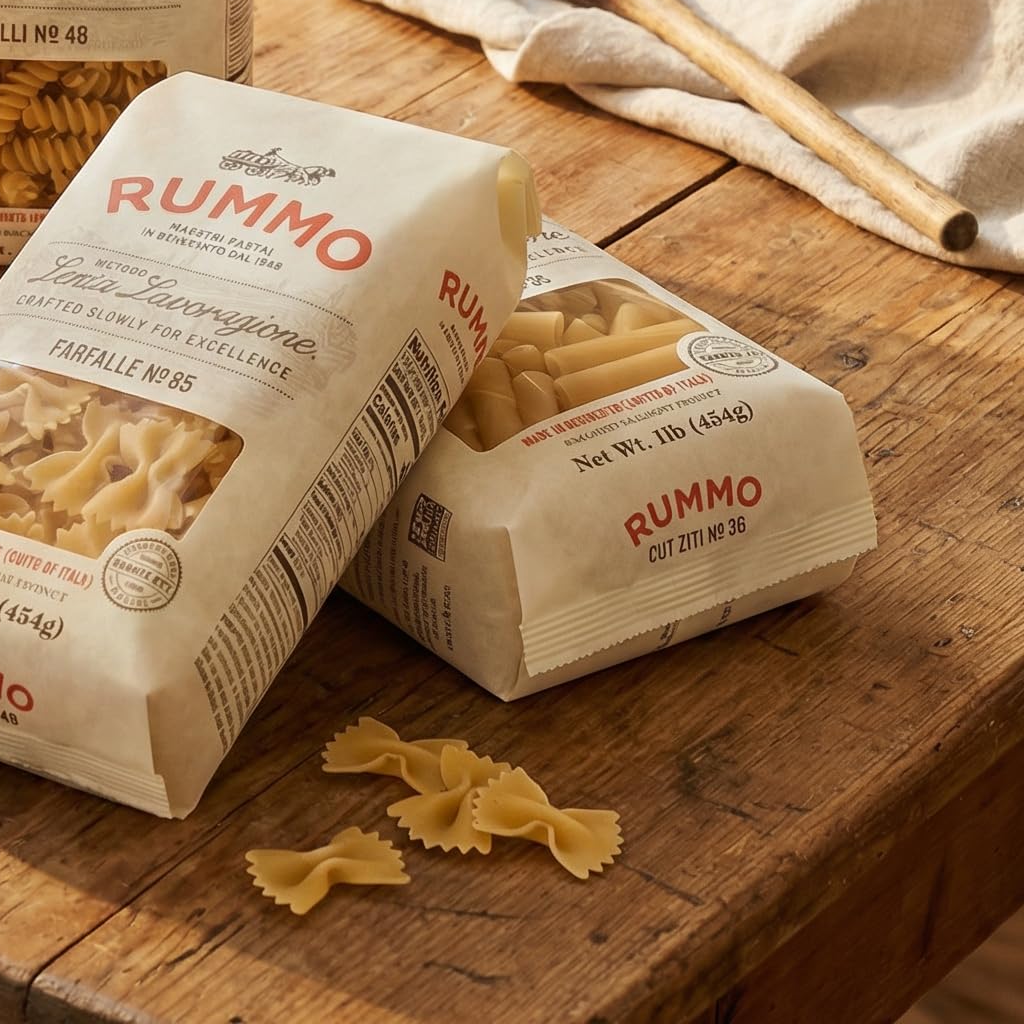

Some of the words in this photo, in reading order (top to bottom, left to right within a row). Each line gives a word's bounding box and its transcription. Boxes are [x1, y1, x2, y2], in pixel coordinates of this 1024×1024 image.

[65, 24, 89, 45] 48
[106, 175, 373, 272] RUMMO
[140, 226, 156, 238] IN
[227, 249, 252, 264] DAL
[16, 294, 84, 315] CRAFTED
[86, 307, 148, 331] SLOWLY
[151, 324, 182, 342] FOR
[185, 333, 294, 381] EXCELLENCE
[49, 338, 144, 378] FARFALLE
[168, 371, 198, 394] 85
[571, 449, 614, 473] Net
[611, 437, 652, 458] Wt.
[689, 400, 754, 436] (454g)
[624, 475, 762, 548] RUMMO
[649, 538, 674, 563] CUT
[678, 529, 704, 553] ZITI
[728, 516, 746, 536] 36
